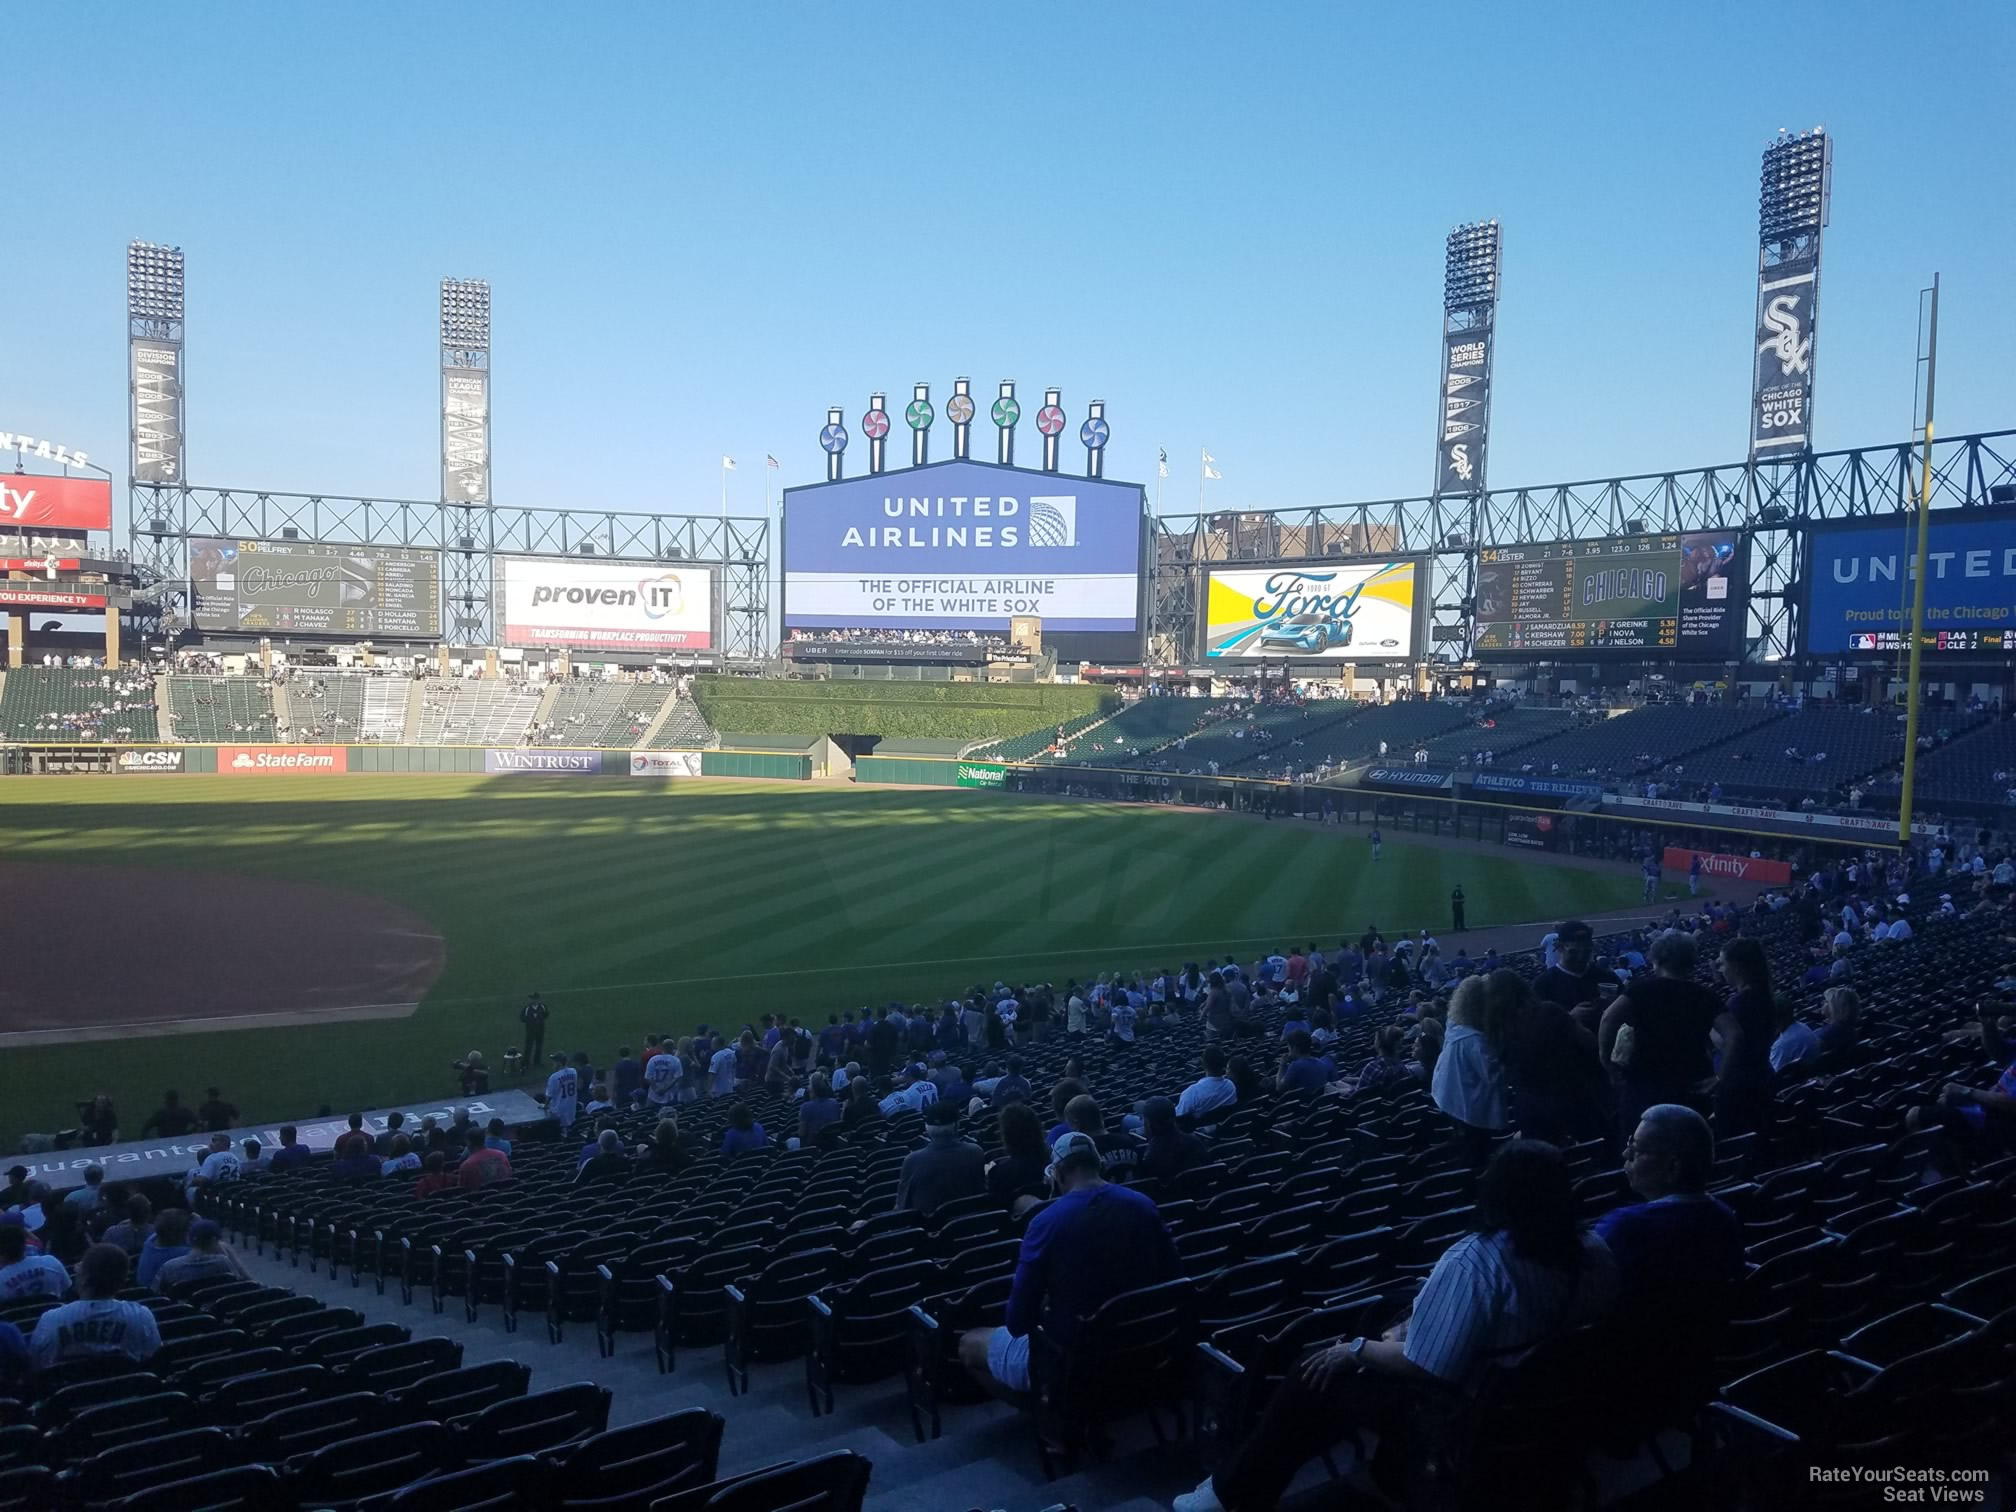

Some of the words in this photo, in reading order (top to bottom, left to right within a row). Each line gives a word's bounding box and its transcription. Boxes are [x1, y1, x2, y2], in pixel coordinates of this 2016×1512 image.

[1451, 342, 1485, 354] WORLD
[138, 352, 175, 360] DIVISION
[138, 358, 175, 366] CHAMPIONS
[1450, 350, 1484, 363] SERIES
[1450, 359, 1484, 368] CHAMPIONS
[1449, 378, 1472, 386] 2005
[1763, 384, 1779, 392] HOME
[1781, 383, 1790, 391] OF
[1762, 388, 1802, 401] CHICAGO
[1450, 402, 1470, 410] 1917
[1762, 398, 1802, 412] WHITE
[1761, 408, 1801, 428] SOX
[884, 496, 1019, 517] UNITED
[842, 526, 1018, 547] AIRLINES
[240, 541, 257, 551] 50
[1482, 550, 1497, 562] 34
[1498, 553, 1524, 561] LESTER
[242, 566, 338, 598] Chicago
[860, 580, 892, 593] THE
[898, 580, 978, 594] OFFICIAL
[984, 580, 1054, 594] AIRLINE
[1583, 568, 1666, 605] CHICAGO
[18, 593, 73, 604] EXPERIENCE
[76, 596, 86, 604] TV
[532, 586, 636, 606] proven
[652, 588, 672, 607] IT
[1254, 572, 1365, 620] Ford
[872, 598, 896, 610] OF
[902, 598, 934, 611] THE
[940, 599, 998, 612] WHITE
[1003, 600, 1040, 612] SOX
[1846, 609, 1884, 621] Proud
[1888, 610, 1900, 620] to
[1928, 608, 1950, 619] the
[1954, 606, 2008, 620] Chicago
[532, 628, 588, 640] TRANSFORMING
[590, 631, 634, 642] WORKPLACE
[636, 633, 687, 643] PRODUCTIVITY
[1948, 632, 1967, 640] LAA
[1948, 641, 1966, 650] CLE
[1971, 641, 1976, 649] 2
[143, 752, 182, 764] CSN
[256, 753, 333, 767] StateFarm
[494, 752, 592, 769] WINTRUST
[968, 768, 1004, 780] National
[1120, 774, 1139, 784] THE
[1388, 771, 1443, 784] HYUNDAI
[1476, 774, 1525, 788] ATHLETICO
[1530, 782, 1550, 791] THE
[1643, 799, 1662, 807] CRAFT
[1732, 808, 1754, 816] CRAFT
[1510, 815, 1537, 823] guaranteed
[1840, 817, 1864, 827] CRAFT
[1700, 856, 1749, 877] xfinity
[655, 1069, 669, 1083] 17
[561, 1083, 575, 1098] 18
[916, 1083, 933, 1094] RIZZO
[26, 1134, 262, 1177] guaranted
